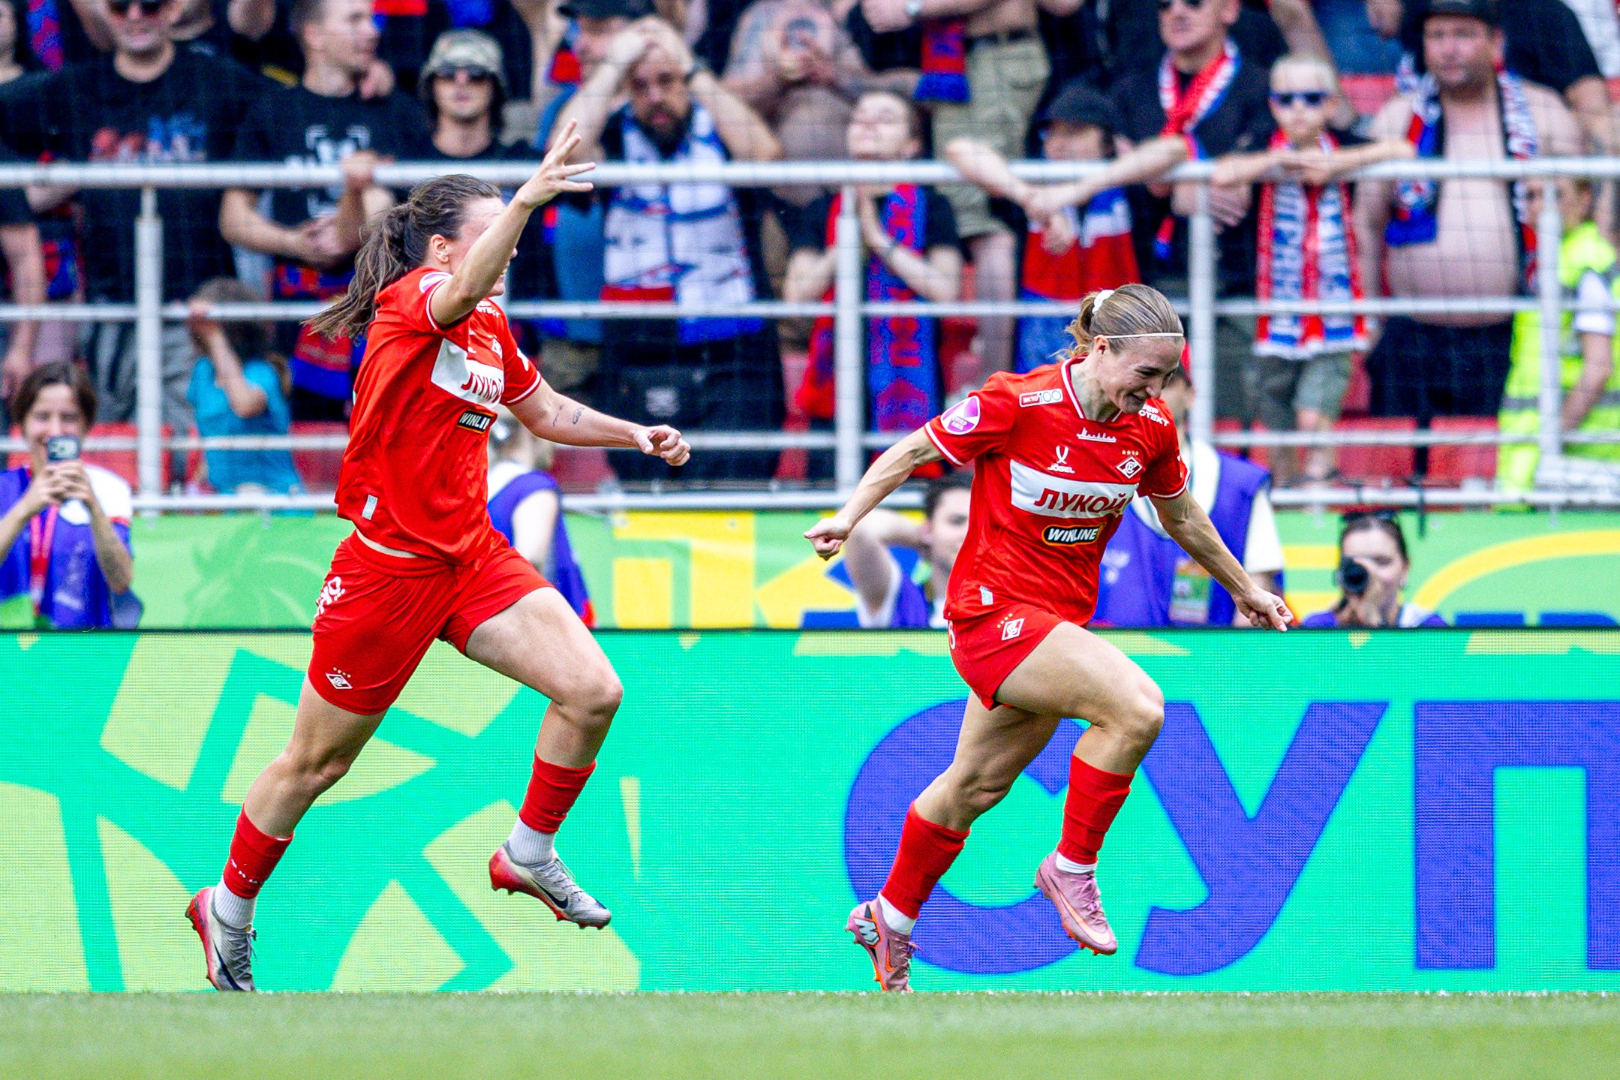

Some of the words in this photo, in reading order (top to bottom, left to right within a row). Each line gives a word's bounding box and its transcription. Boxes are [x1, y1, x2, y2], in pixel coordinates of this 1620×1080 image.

[1138, 409, 1170, 427] ОТЕКТ
[1033, 487, 1131, 516] ЛУКОЙ
[1047, 527, 1099, 543] WINLINE
[843, 699, 1620, 977] СУП
